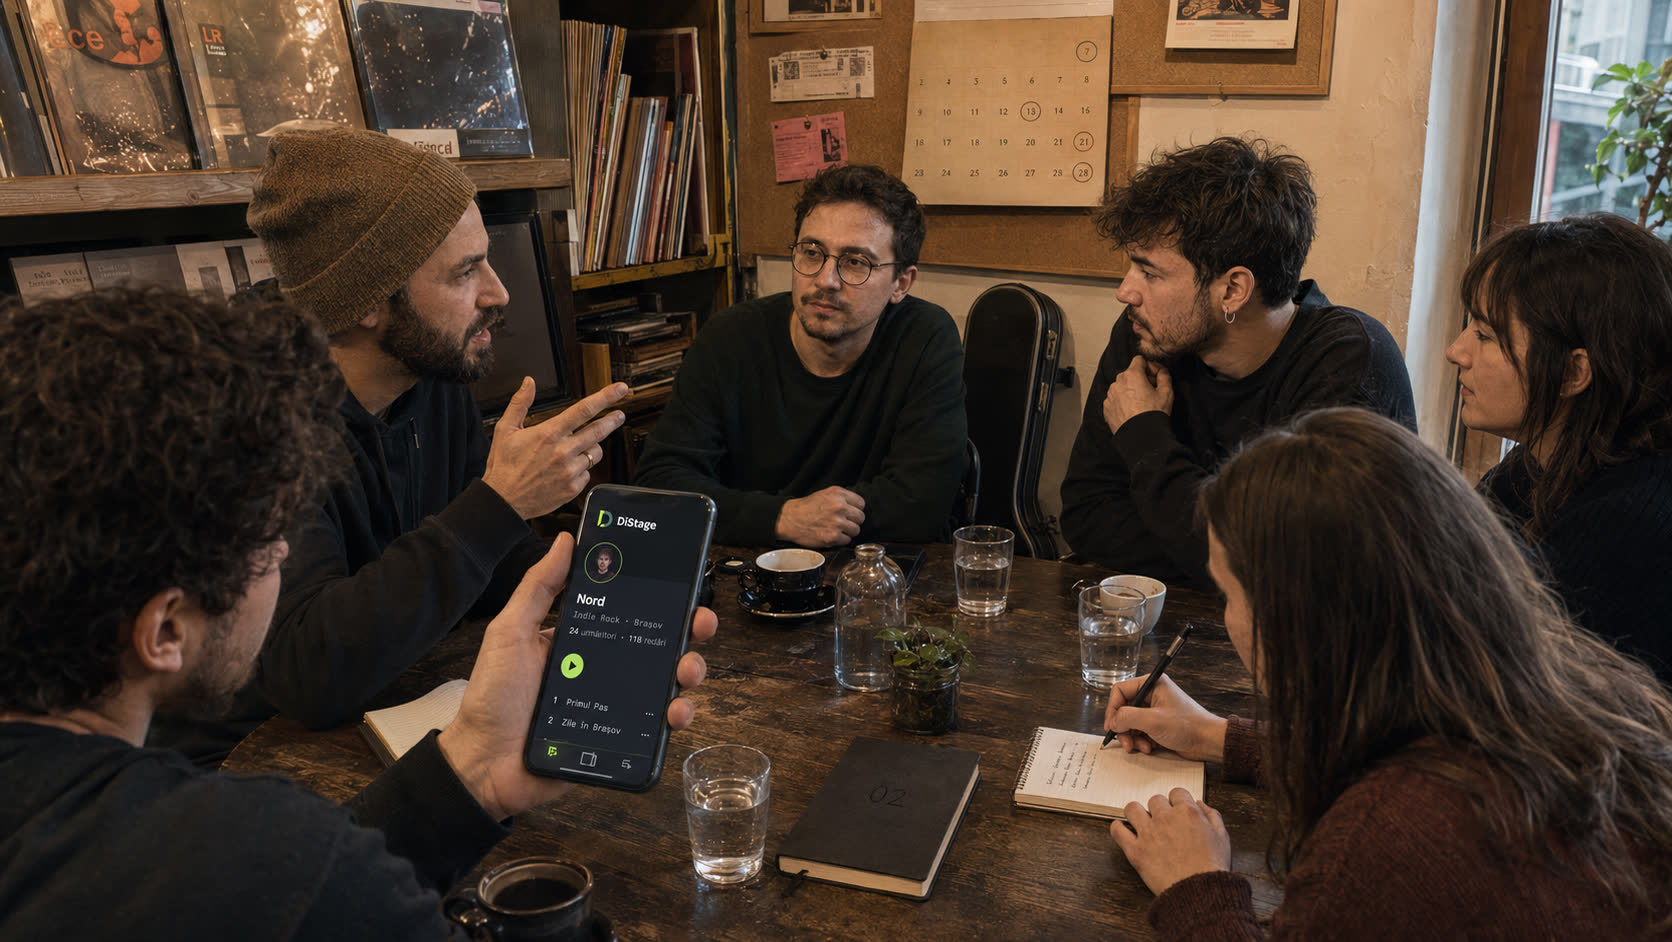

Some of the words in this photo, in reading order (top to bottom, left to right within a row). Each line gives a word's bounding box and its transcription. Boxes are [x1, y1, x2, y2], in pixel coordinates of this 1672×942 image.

[202, 25, 224, 44] LR
[1084, 75, 1090, 83] 8
[943, 108, 952, 116] 10
[971, 108, 979, 116] 11
[999, 108, 1008, 116] 12
[1027, 107, 1036, 116] 13
[1055, 107, 1063, 115] 14
[943, 138, 952, 146] 17
[999, 138, 1008, 146] 19
[1025, 138, 1036, 146] 20
[1053, 138, 1063, 146] 21
[1079, 138, 1089, 146] 21
[914, 169, 924, 177] 23
[970, 169, 980, 177] 25
[998, 169, 1009, 177] 26
[1025, 169, 1036, 177] 27
[1079, 168, 1089, 177] 28
[616, 516, 657, 532] DiStage
[576, 593, 606, 607] Nord
[573, 610, 596, 621] Indie
[600, 613, 620, 624] Rock
[568, 626, 579, 635] 24
[629, 635, 642, 644] 118
[552, 696, 558, 704] 1
[565, 698, 591, 709] Primul
[593, 702, 609, 712] Pas
[547, 716, 554, 725] 2
[561, 718, 577, 728] Zile
[869, 784, 906, 808] 02
